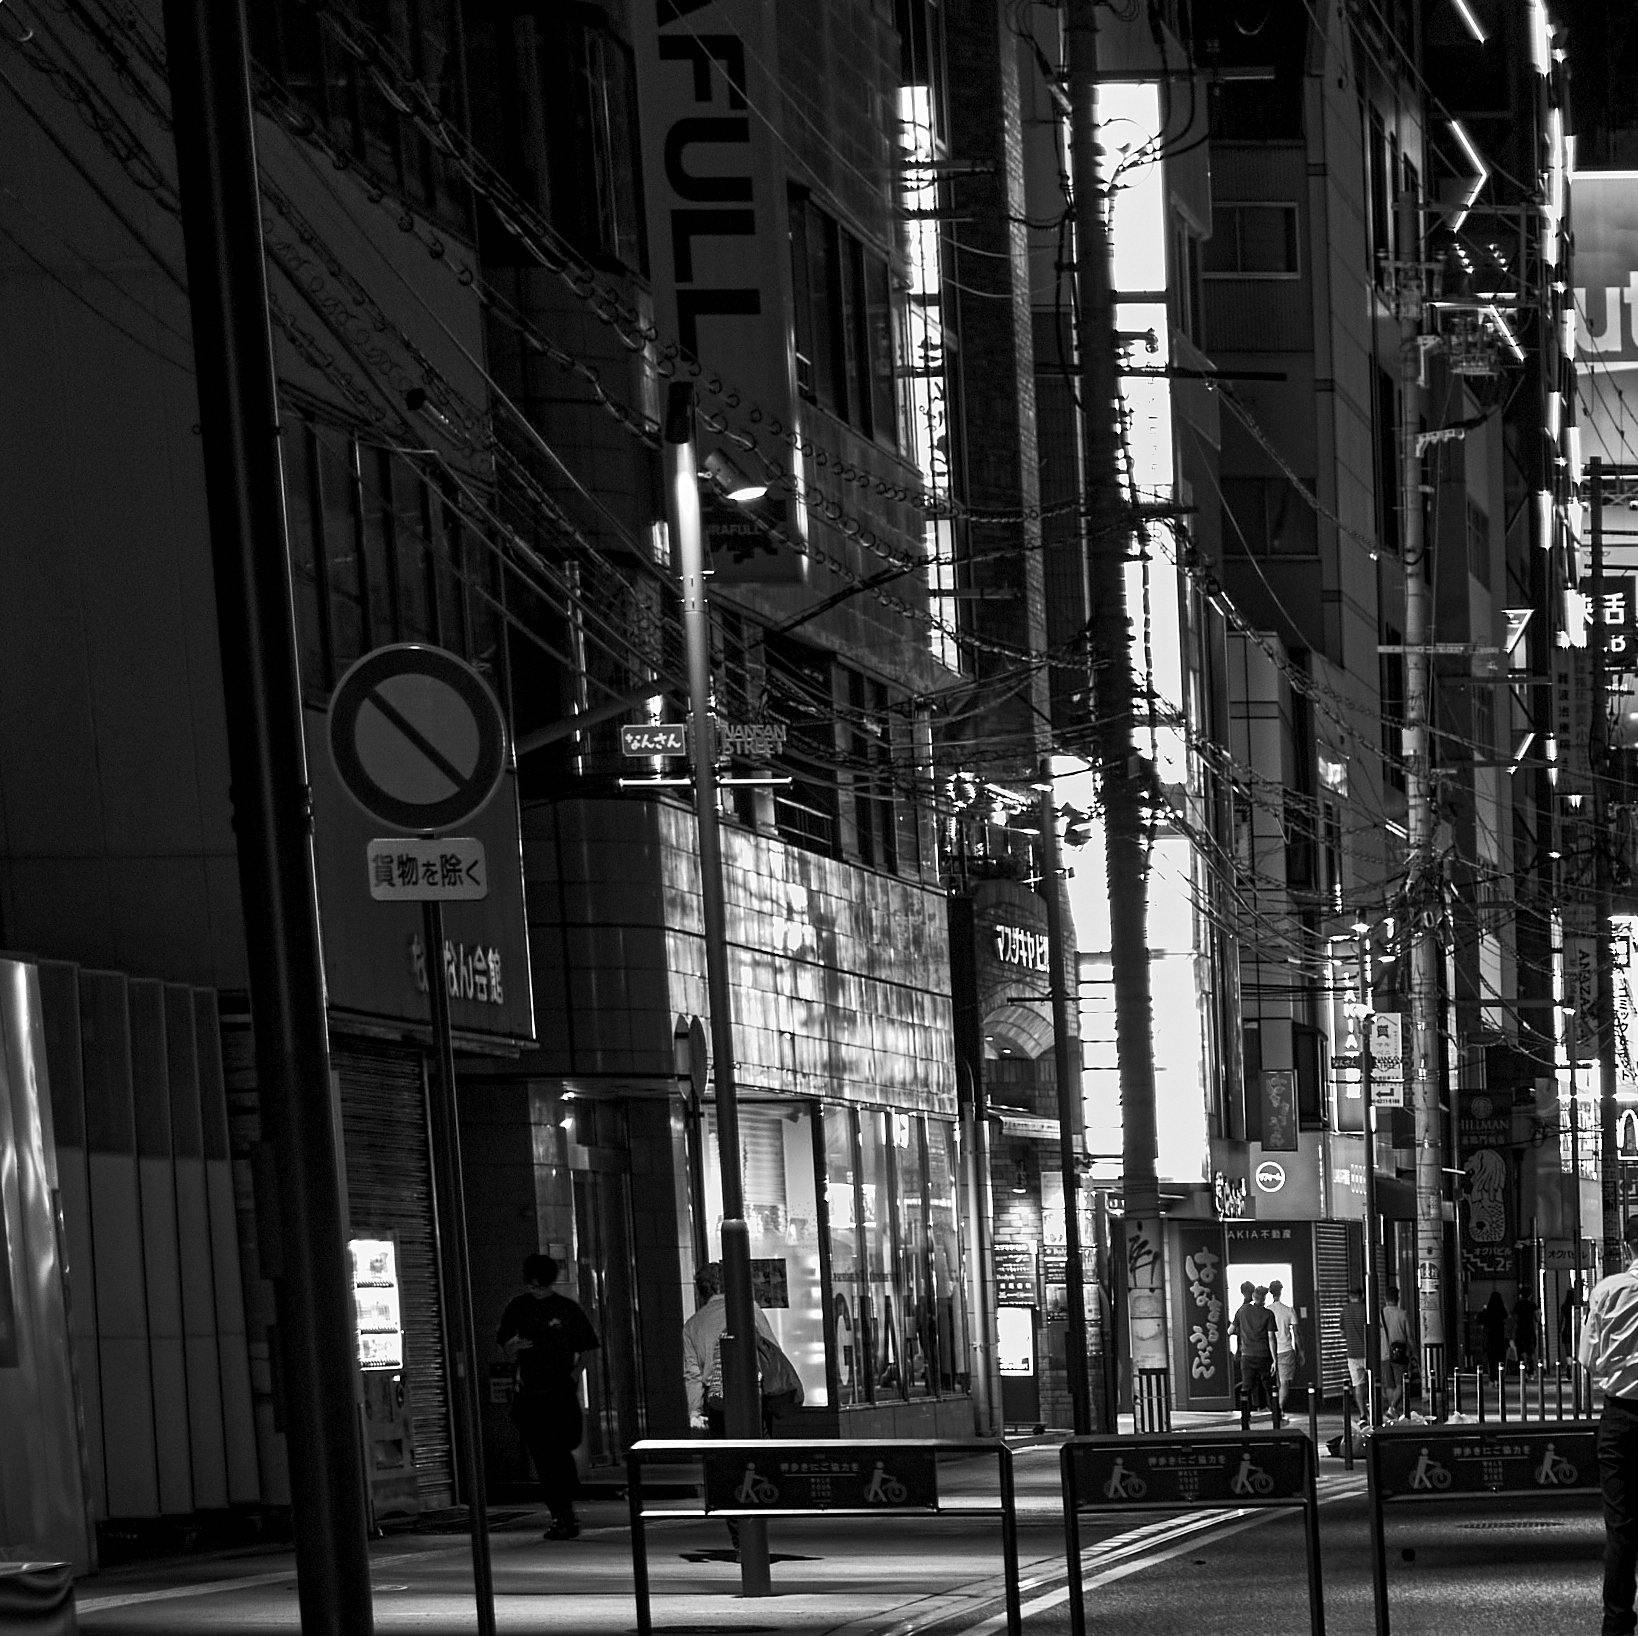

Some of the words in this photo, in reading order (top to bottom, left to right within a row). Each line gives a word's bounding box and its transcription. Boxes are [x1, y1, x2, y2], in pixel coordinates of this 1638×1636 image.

[625, 733, 681, 750] なんさん
[373, 854, 480, 887] 貨物を除く
[412, 934, 503, 1004] ななん会館
